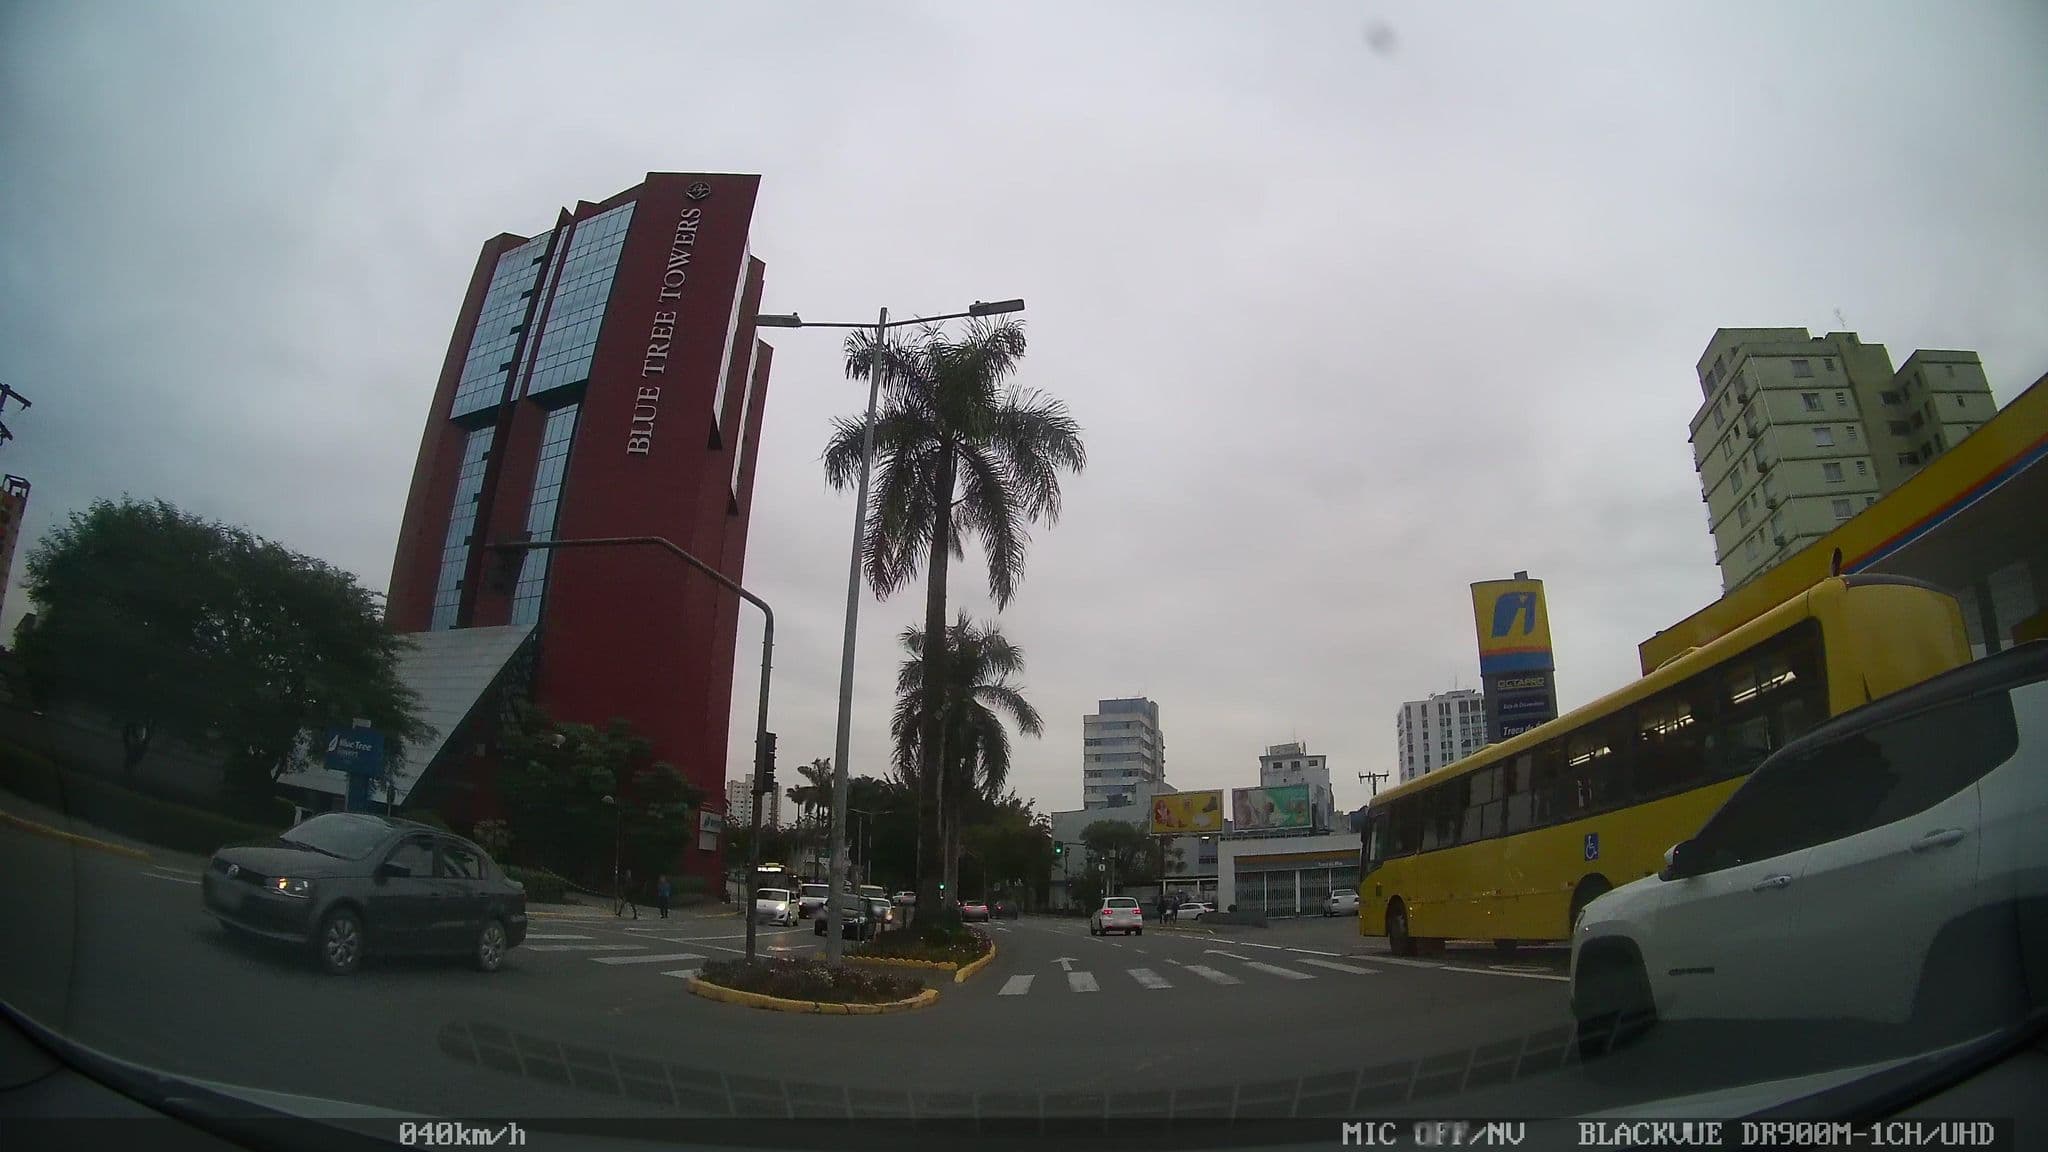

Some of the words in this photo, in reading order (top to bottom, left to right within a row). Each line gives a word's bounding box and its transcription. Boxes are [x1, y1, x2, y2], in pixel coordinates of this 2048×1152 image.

[657, 207, 702, 304] TOWERS
[642, 310, 677, 378] TREE
[626, 386, 661, 456] BLUE
